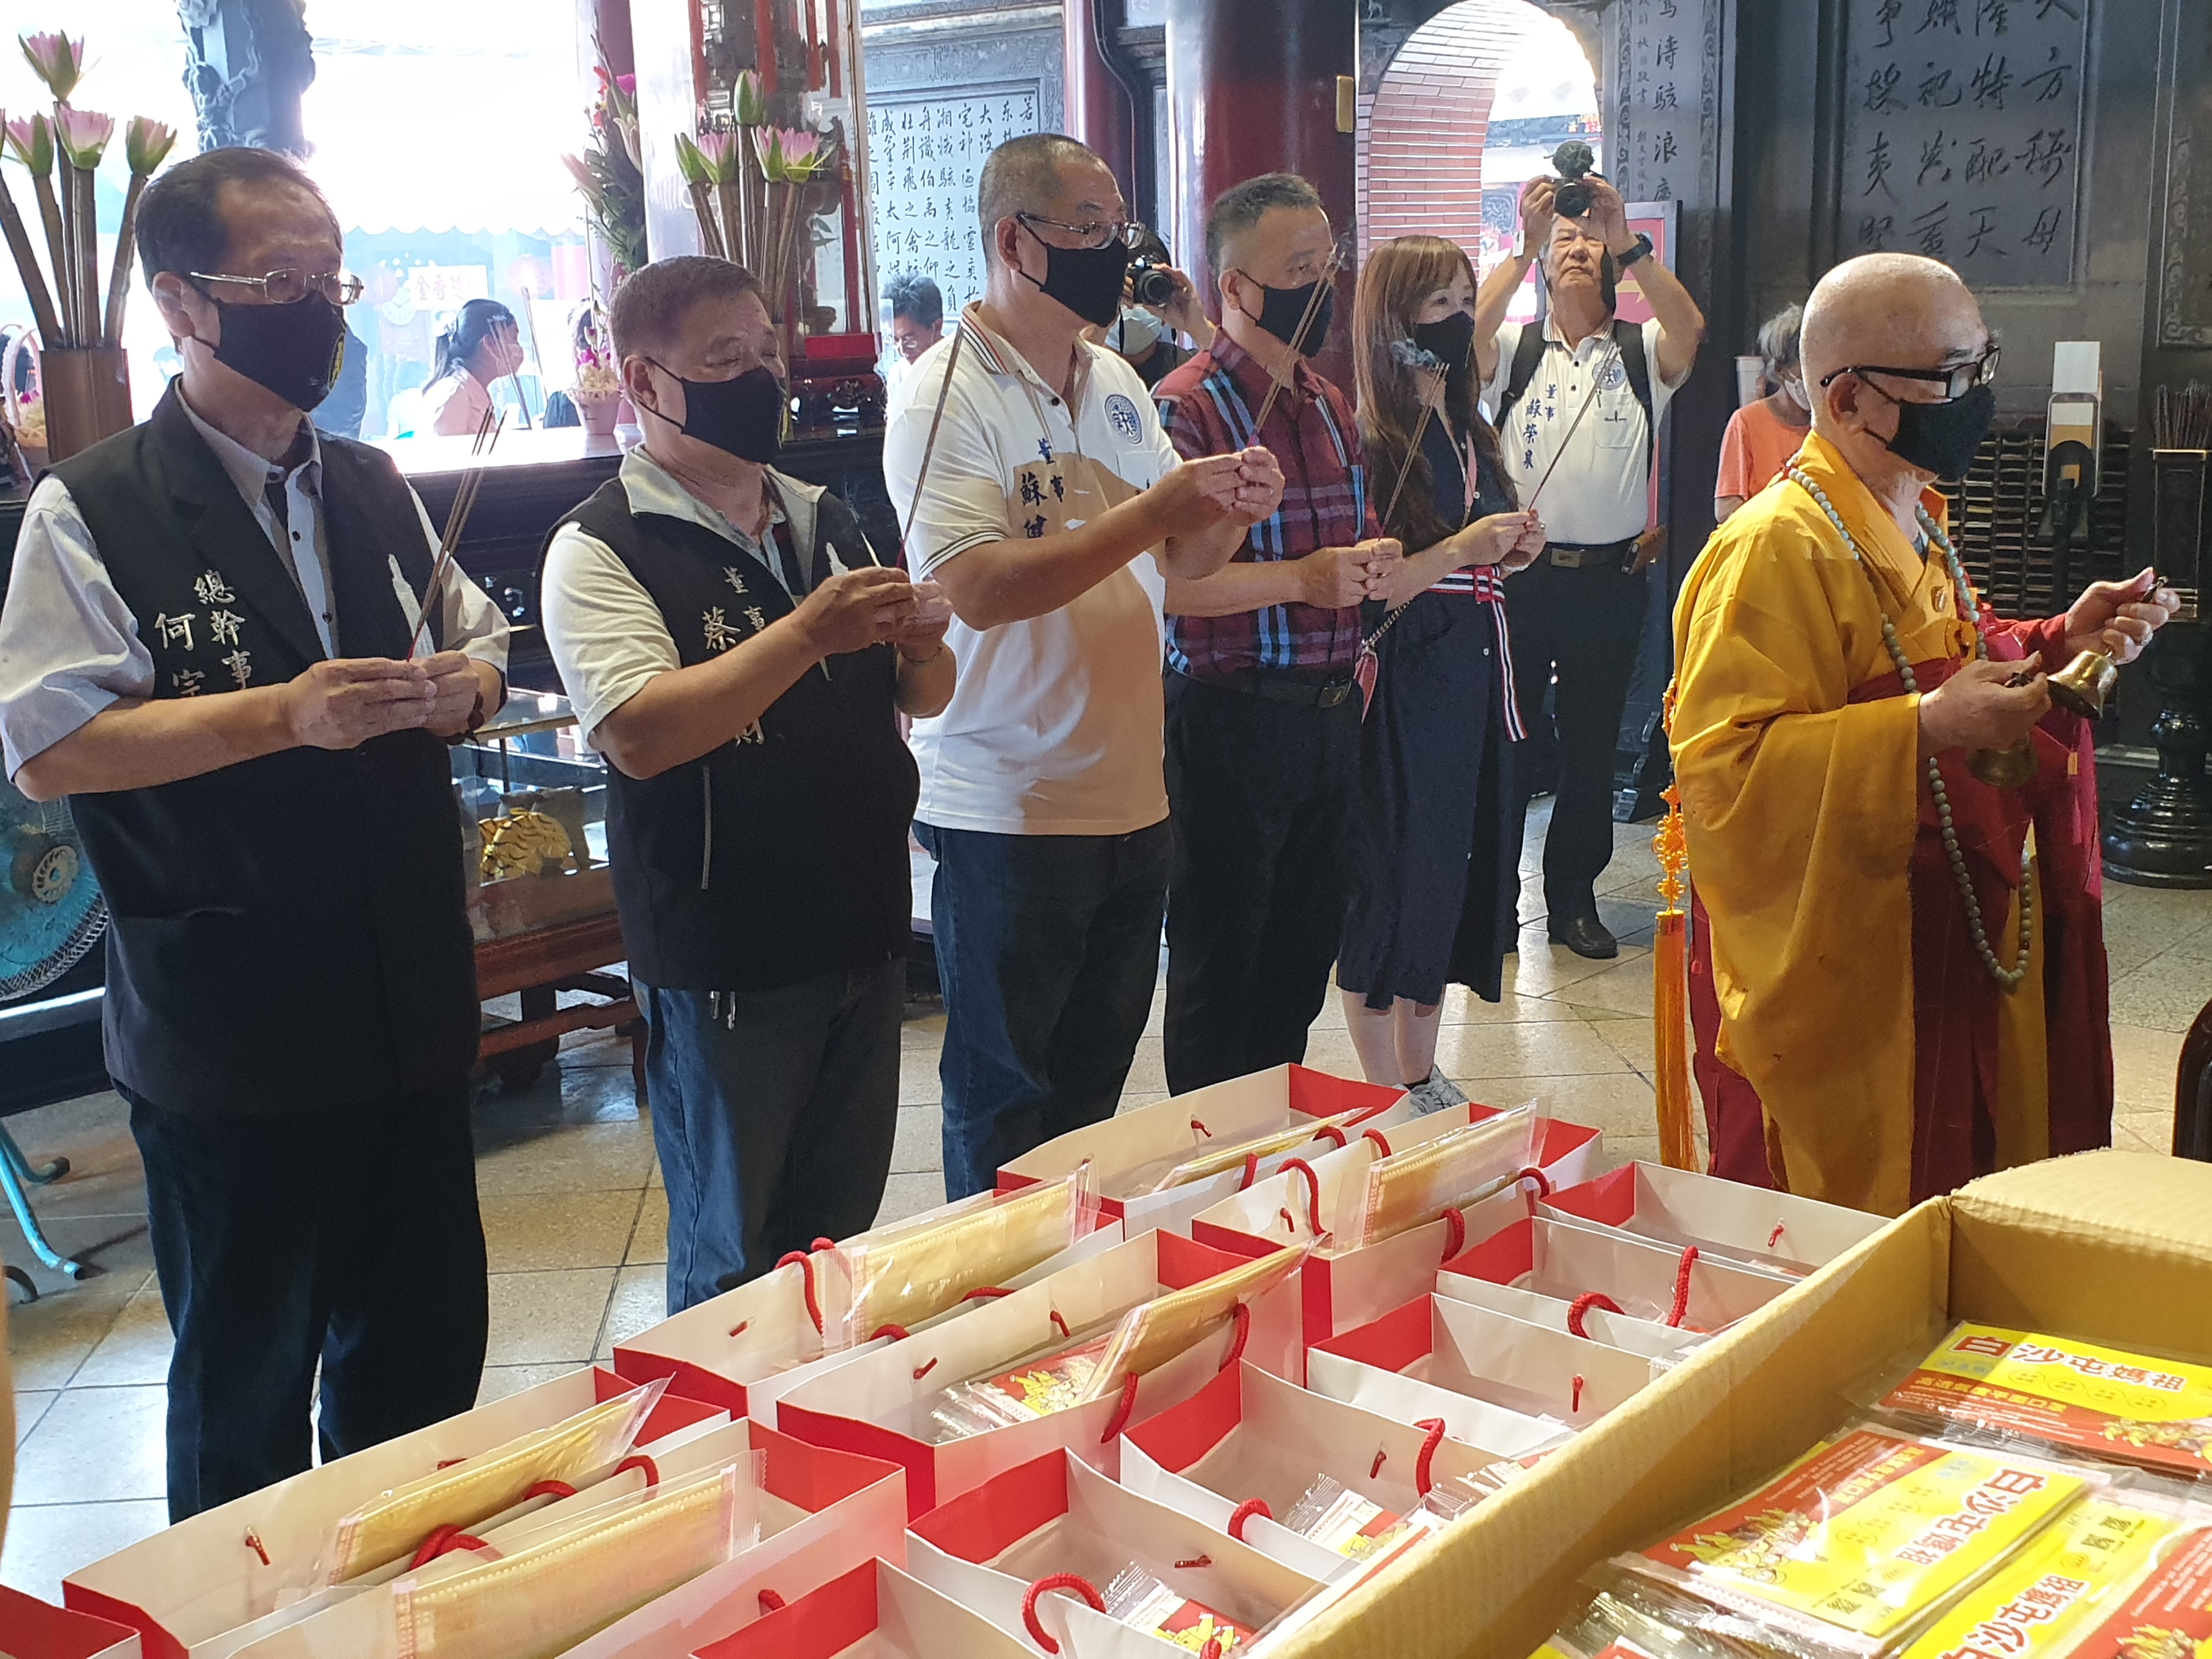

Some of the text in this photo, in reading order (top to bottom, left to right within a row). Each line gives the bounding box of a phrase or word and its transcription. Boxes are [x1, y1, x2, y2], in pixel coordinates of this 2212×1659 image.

[1545, 383, 1558, 422] 董事
[1038, 437, 1065, 503] 董事
[194, 569, 252, 689] 總幹事
[722, 566, 765, 631] 董事
[1953, 1335, 2186, 1390] 白沙屯媽祖
[1895, 1470, 2047, 1565] 白沙屯媽祖
